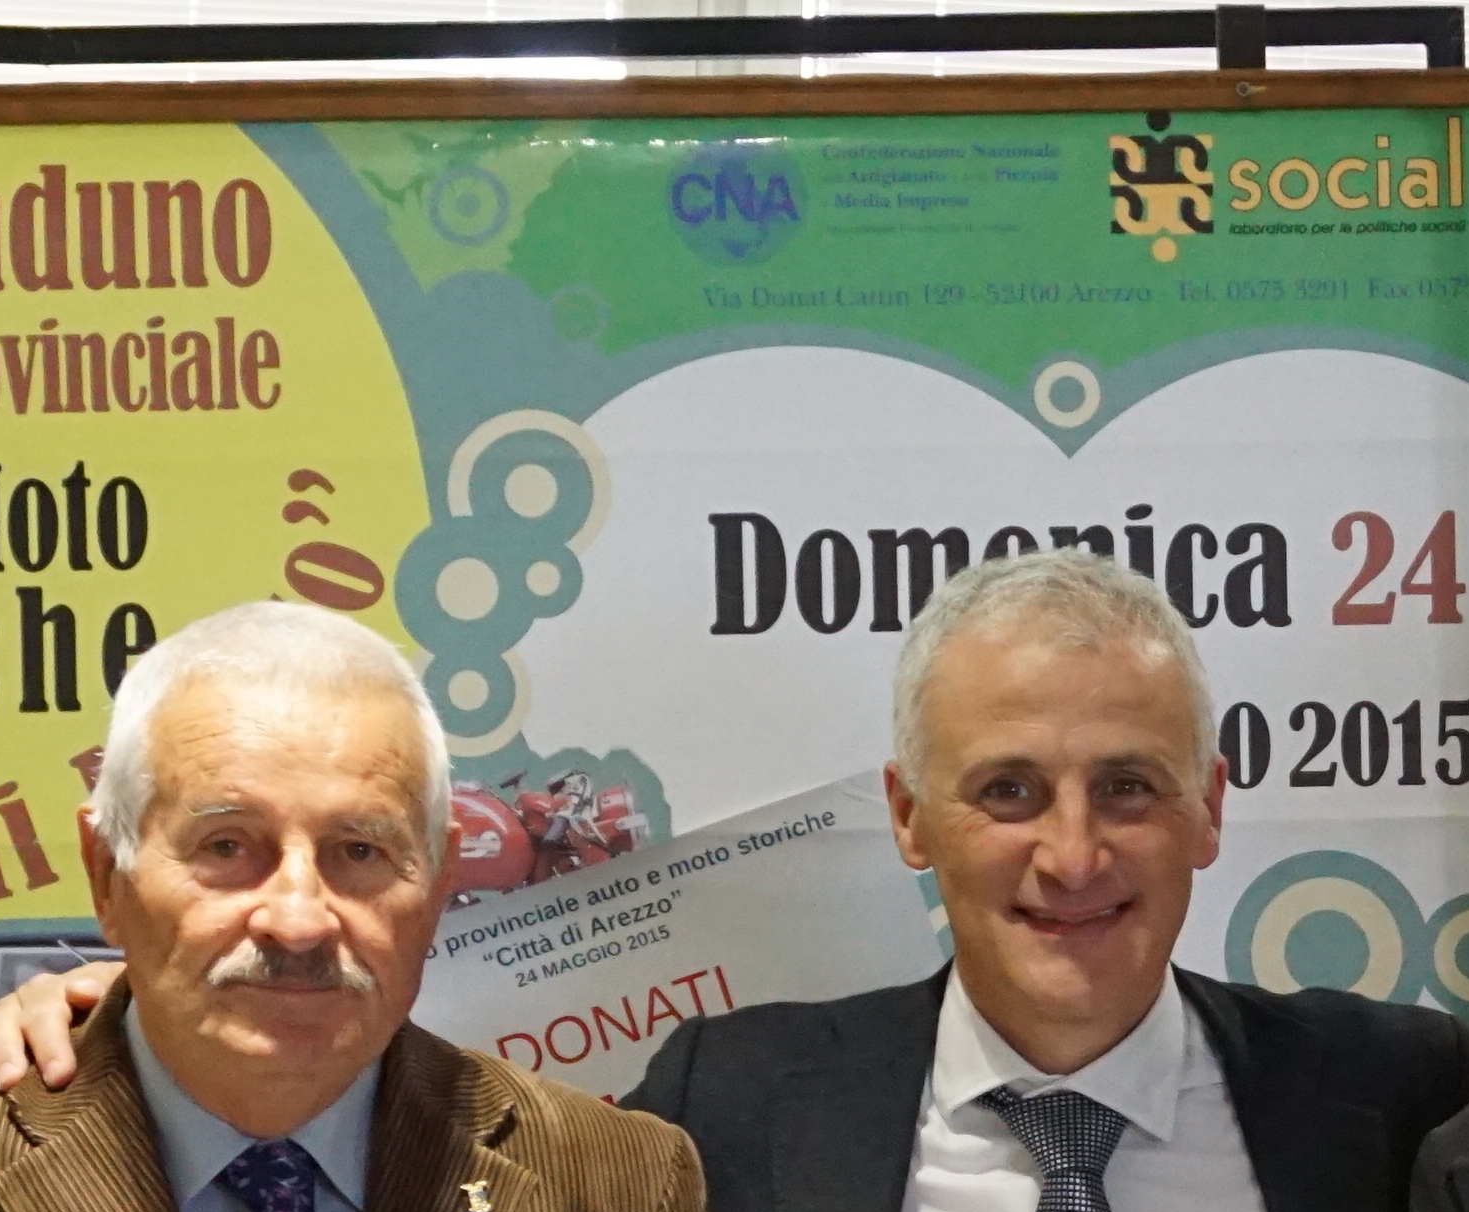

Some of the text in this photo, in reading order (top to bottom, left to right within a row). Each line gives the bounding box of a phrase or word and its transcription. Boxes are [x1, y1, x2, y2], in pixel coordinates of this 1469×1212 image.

[671, 172, 800, 224] CNA
[1229, 220, 1307, 235] laboratorio
[1310, 222, 1336, 236] per
[1339, 221, 1353, 234] le
[1356, 220, 1417, 235] politiche
[1330, 508, 1466, 625] 24
[443, 892, 581, 960] provinciale
[585, 874, 641, 909] auto
[646, 865, 663, 886] e
[667, 843, 731, 881] moto
[736, 807, 838, 858] storiche
[515, 924, 671, 989] 24 MAGGIO 2015
[560, 922, 585, 949] di
[495, 964, 736, 1075] DONATI
